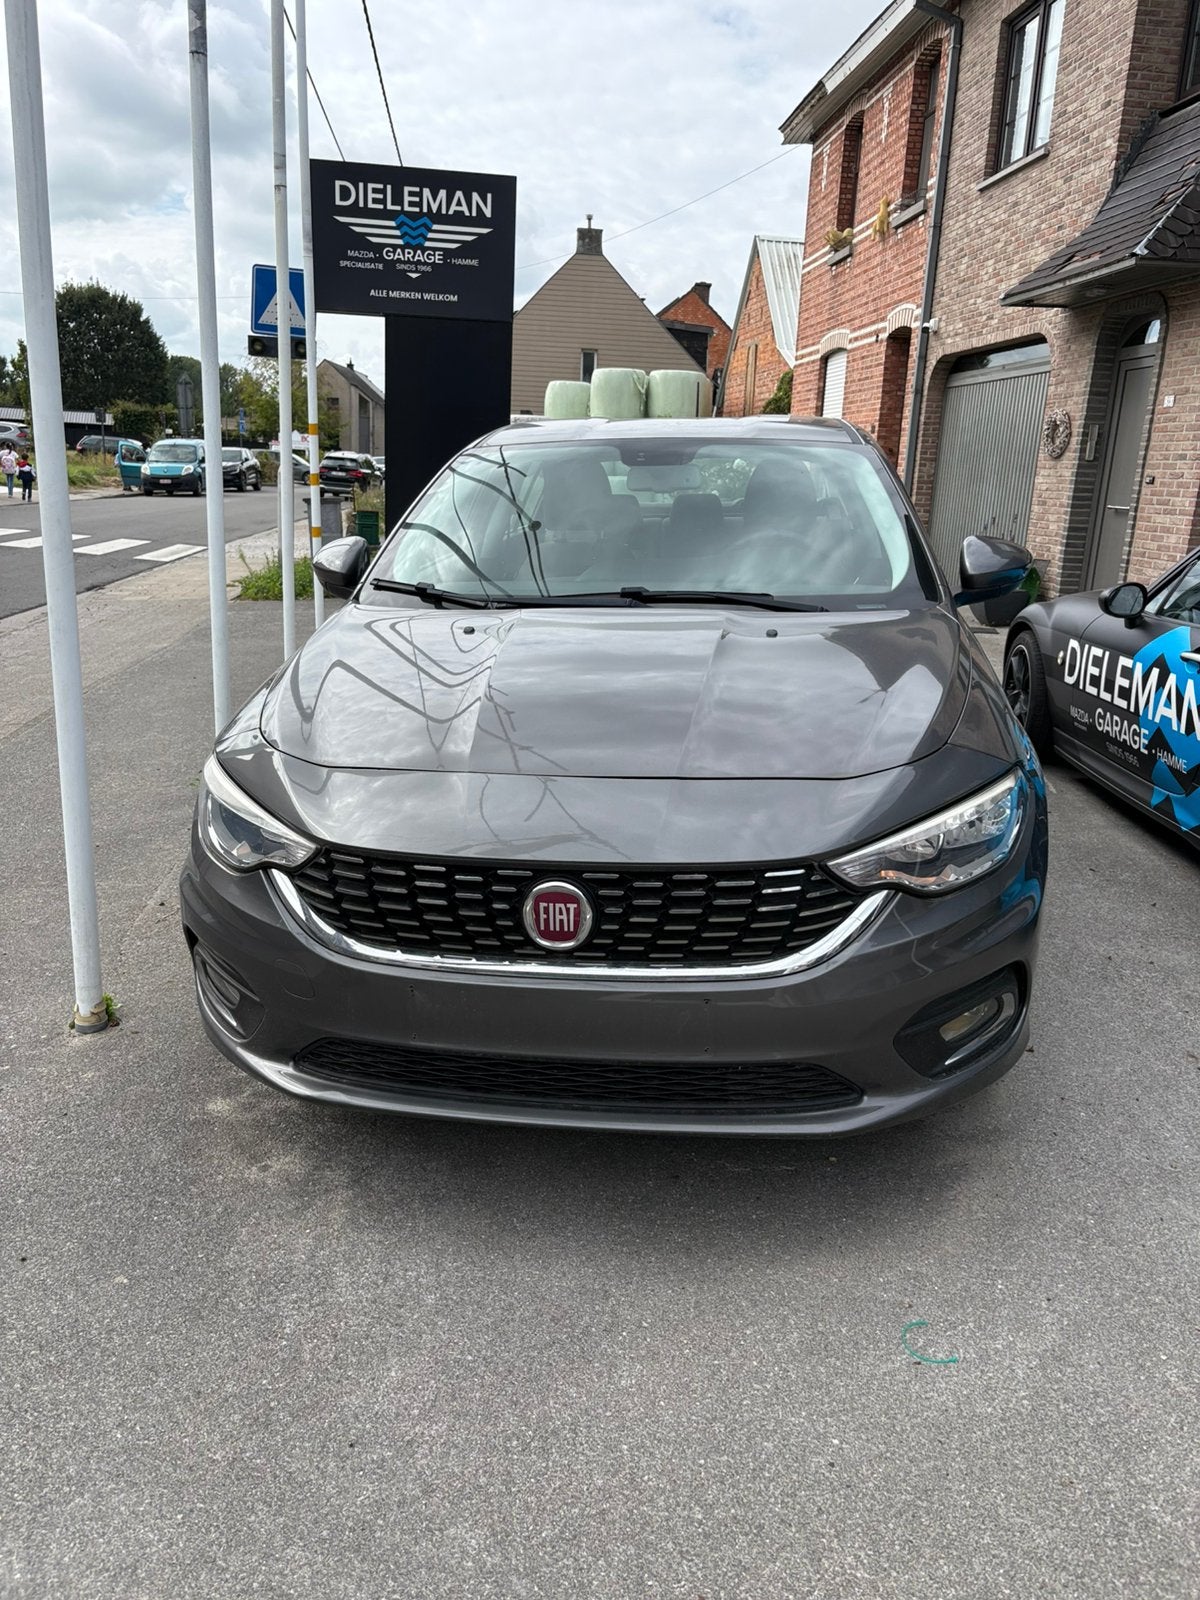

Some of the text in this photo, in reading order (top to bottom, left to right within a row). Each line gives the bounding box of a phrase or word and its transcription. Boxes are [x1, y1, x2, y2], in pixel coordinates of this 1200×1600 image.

[334, 179, 493, 218] DIELEMAN
[339, 260, 384, 270] SPECIALISATIE
[347, 247, 480, 267] MAZDA GARAGE HAMME
[396, 263, 432, 272] SINDS 1966
[369, 289, 458, 302] ALLE MERKEN WELKOM
[1063, 638, 1200, 742] DIELEMAN
[1070, 704, 1090, 725] MAZDA
[1095, 707, 1149, 755] GARAGE
[1156, 747, 1188, 774] HAMME
[539, 902, 578, 932] FIAT
